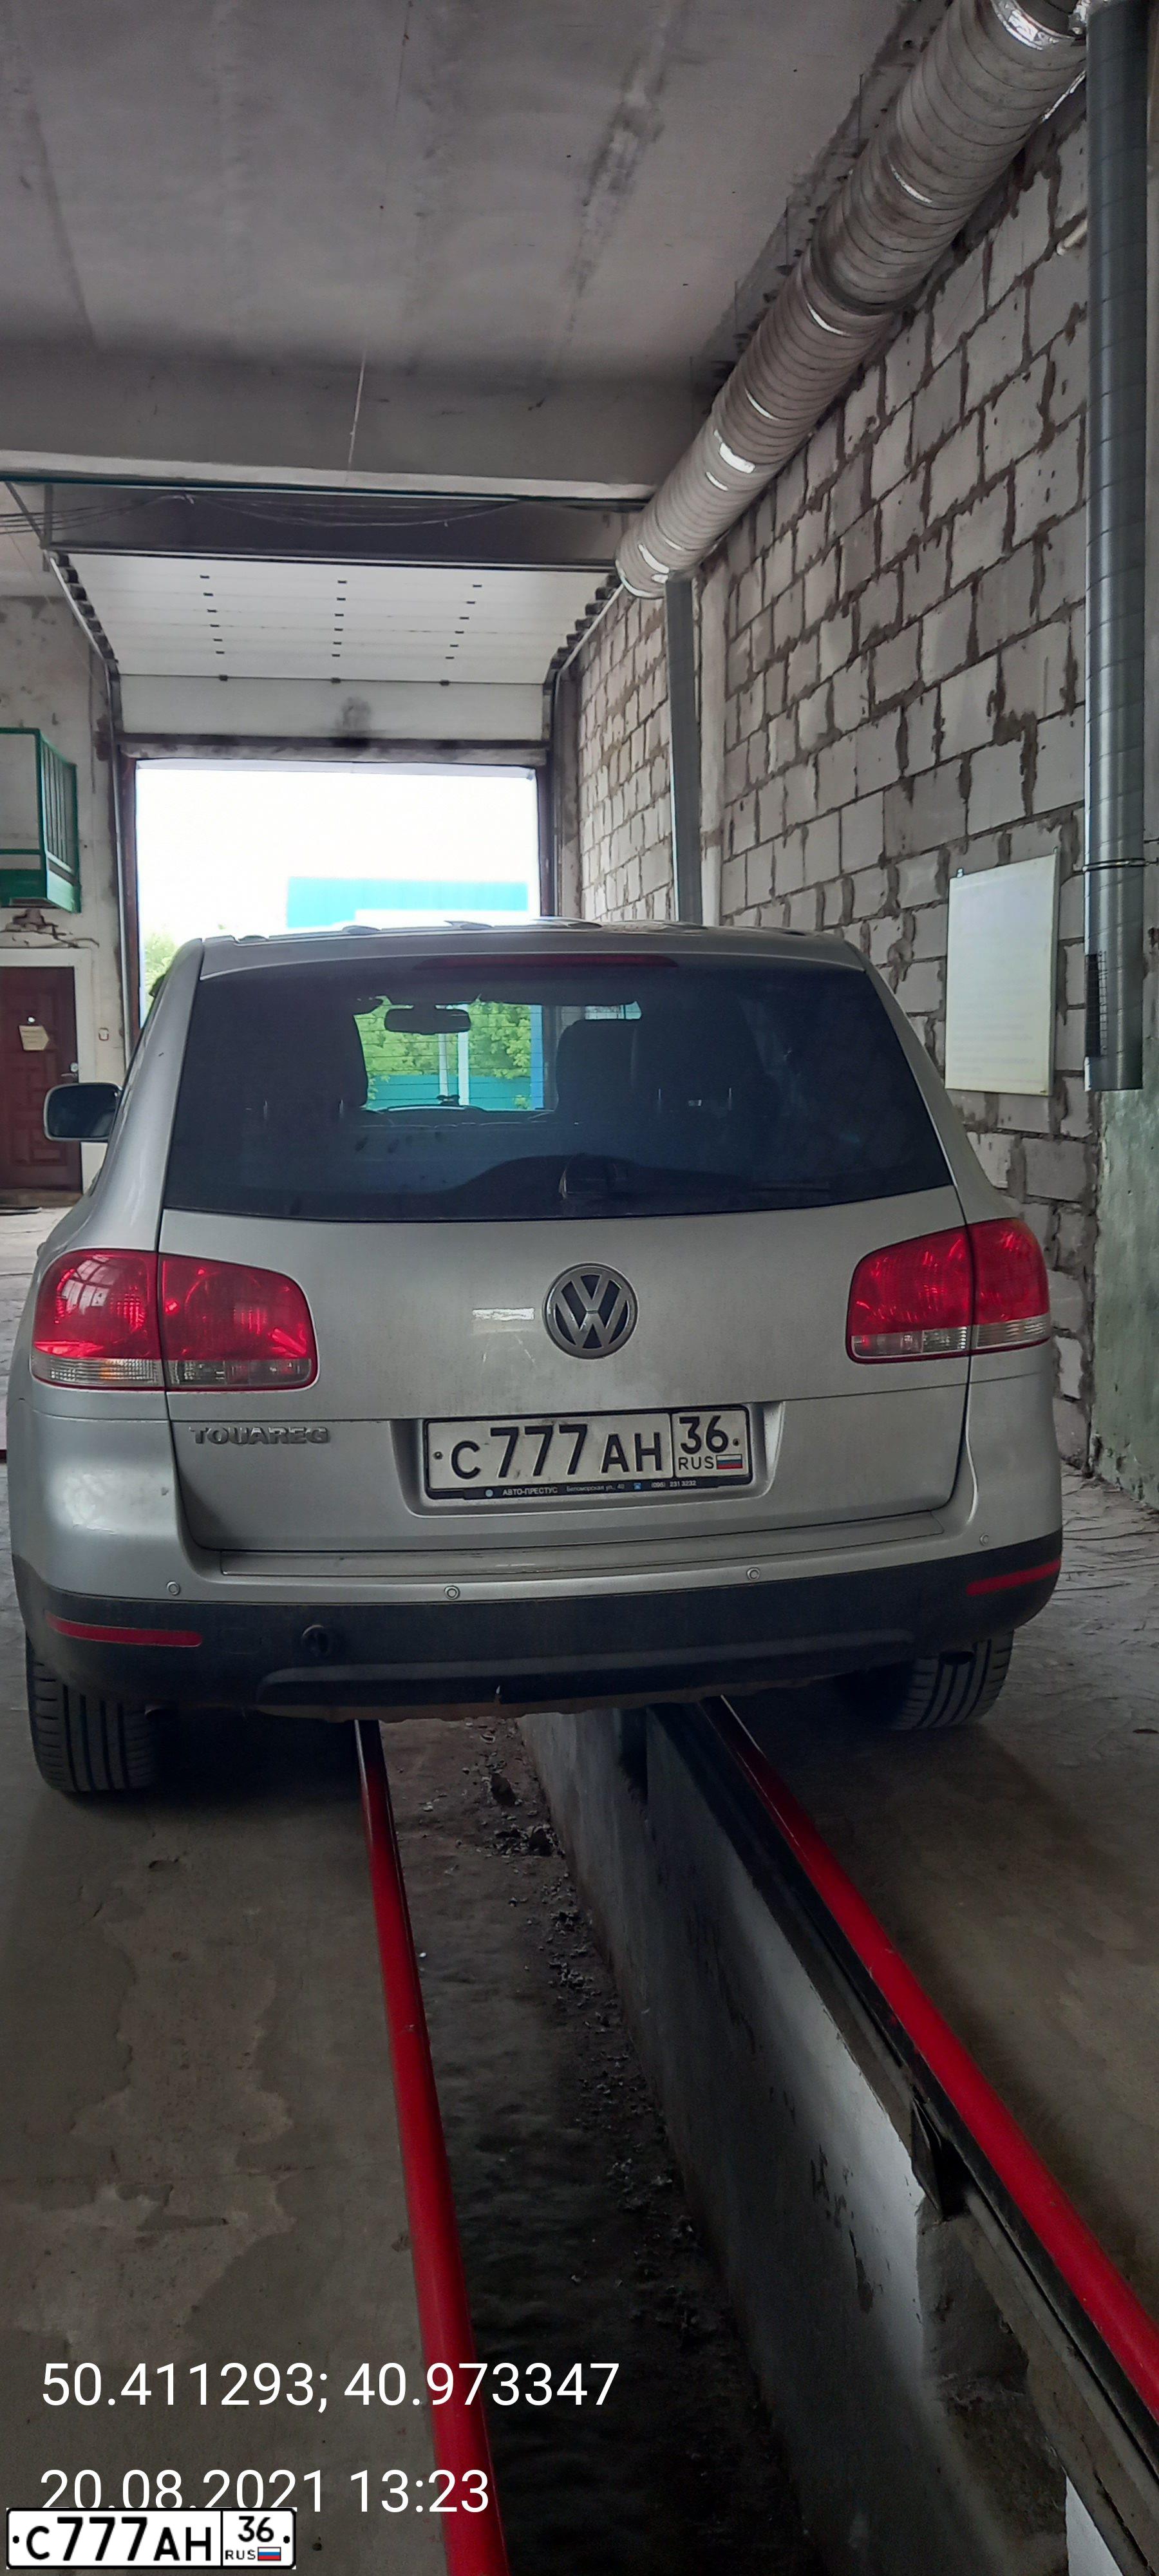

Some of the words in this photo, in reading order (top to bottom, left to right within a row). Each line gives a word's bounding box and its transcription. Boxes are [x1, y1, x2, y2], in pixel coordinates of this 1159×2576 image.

[189, 1426, 330, 1445] TOUAREG
[679, 1415, 729, 1454] 36
[678, 1455, 715, 1470] RUS
